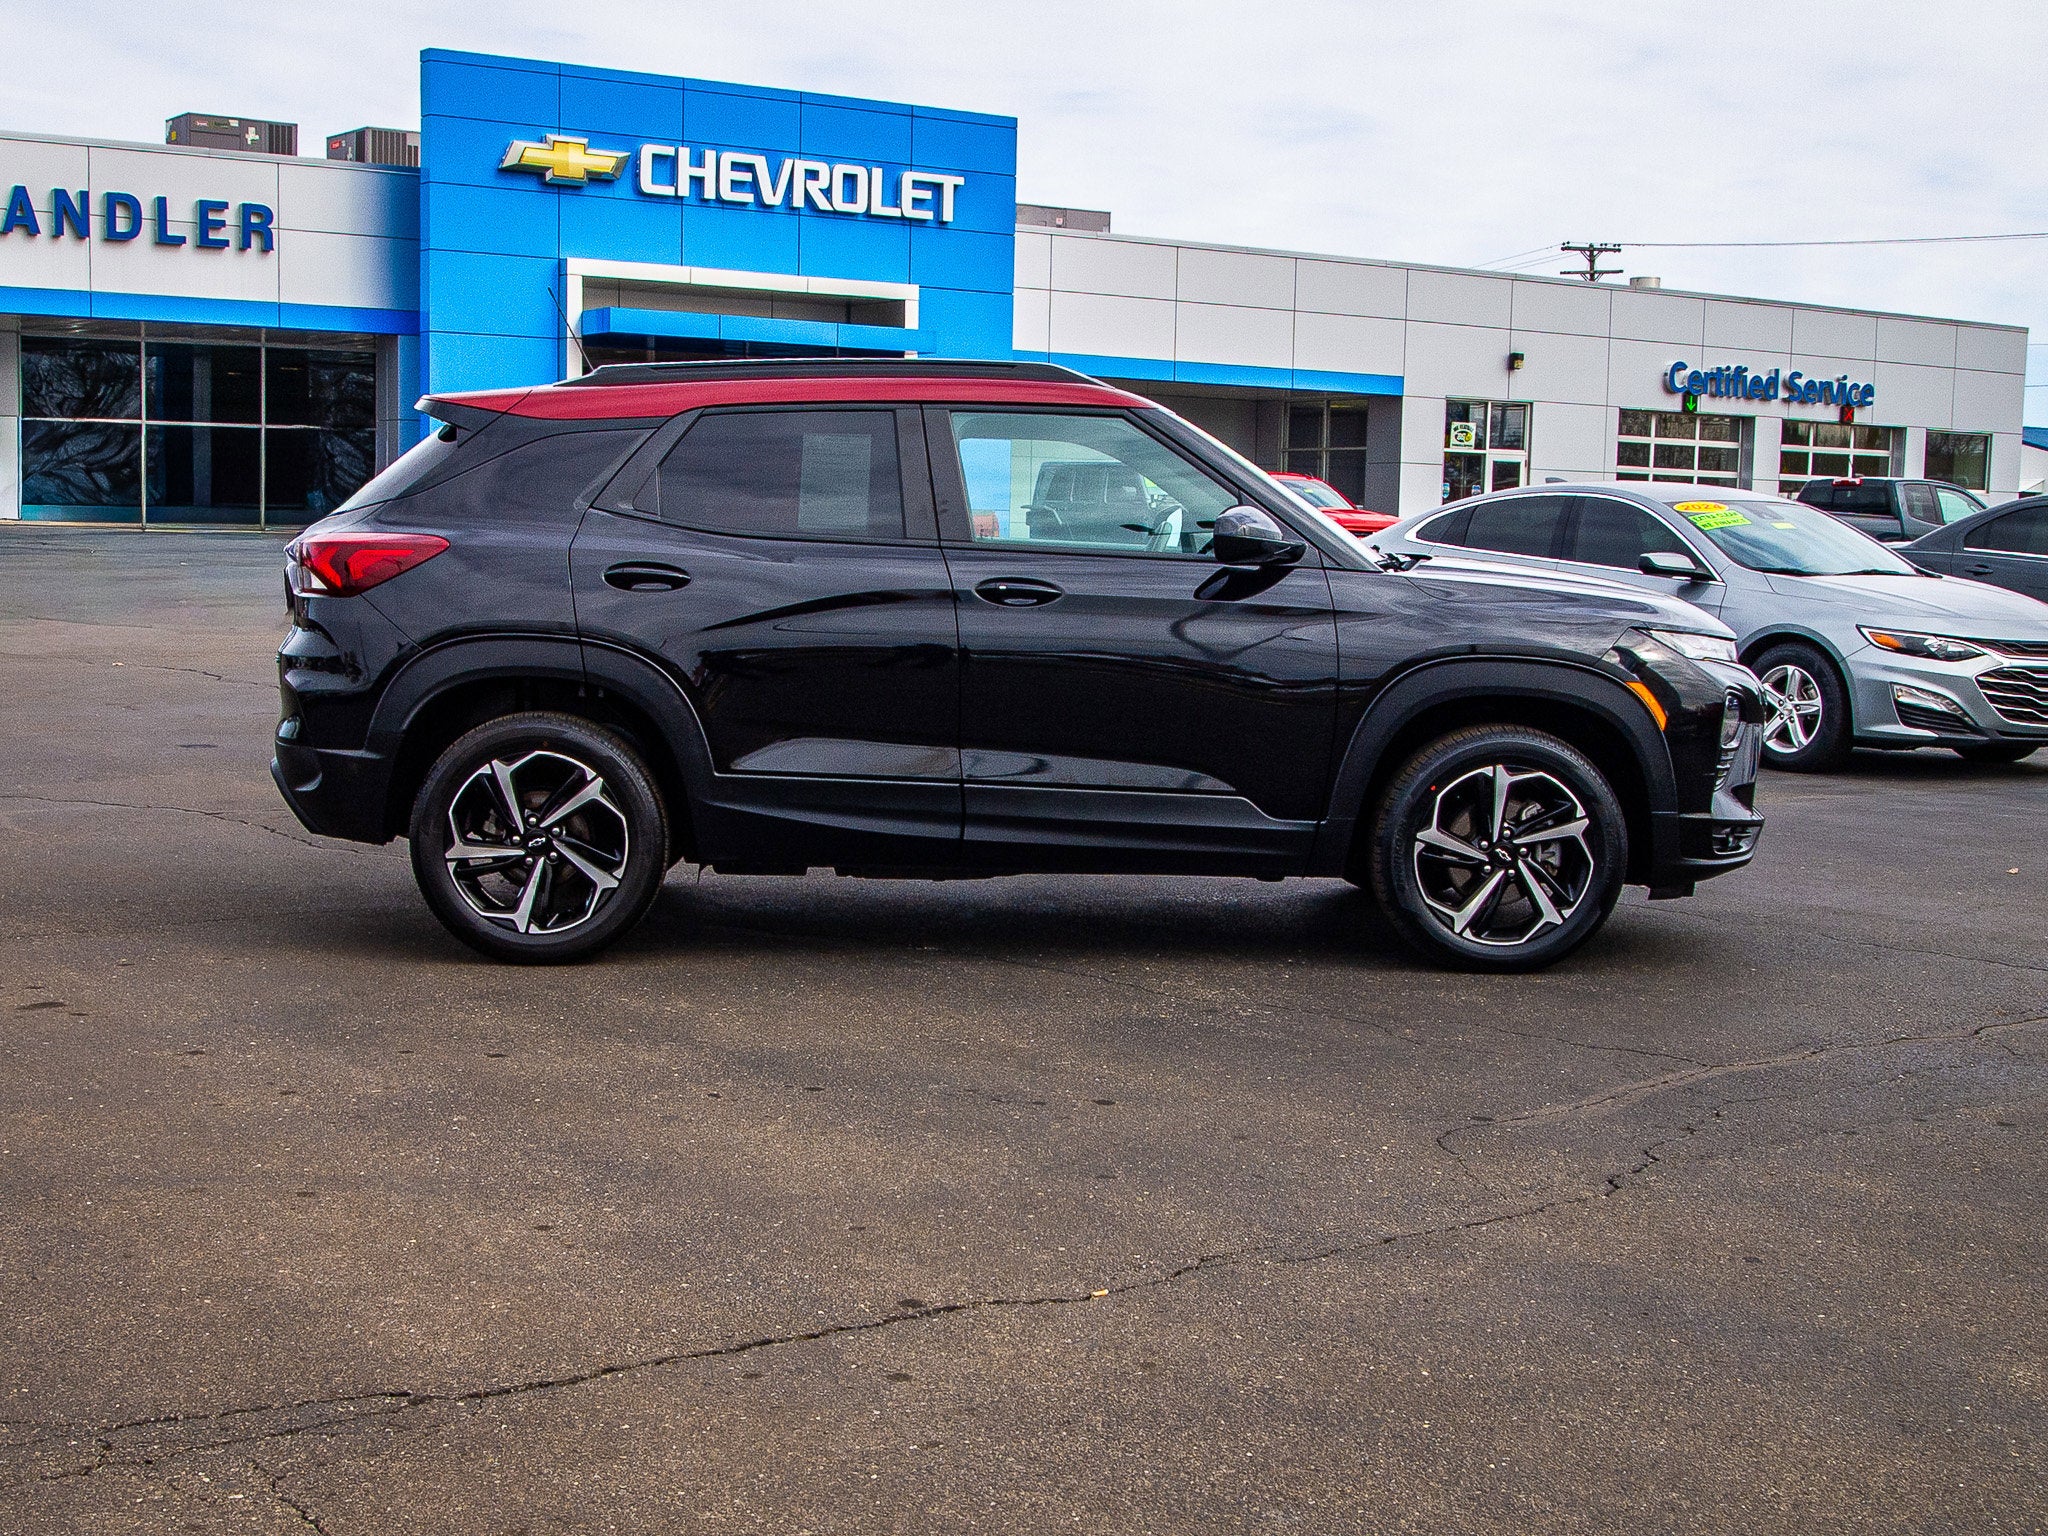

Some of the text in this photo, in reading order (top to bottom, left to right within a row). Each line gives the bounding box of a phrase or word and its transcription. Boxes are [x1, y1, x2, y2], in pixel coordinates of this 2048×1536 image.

[640, 143, 965, 222] CHEVROLET
[0, 184, 275, 252] ANDLER
[1667, 361, 1875, 407] Certified Service
[1682, 503, 1723, 511] 2024
